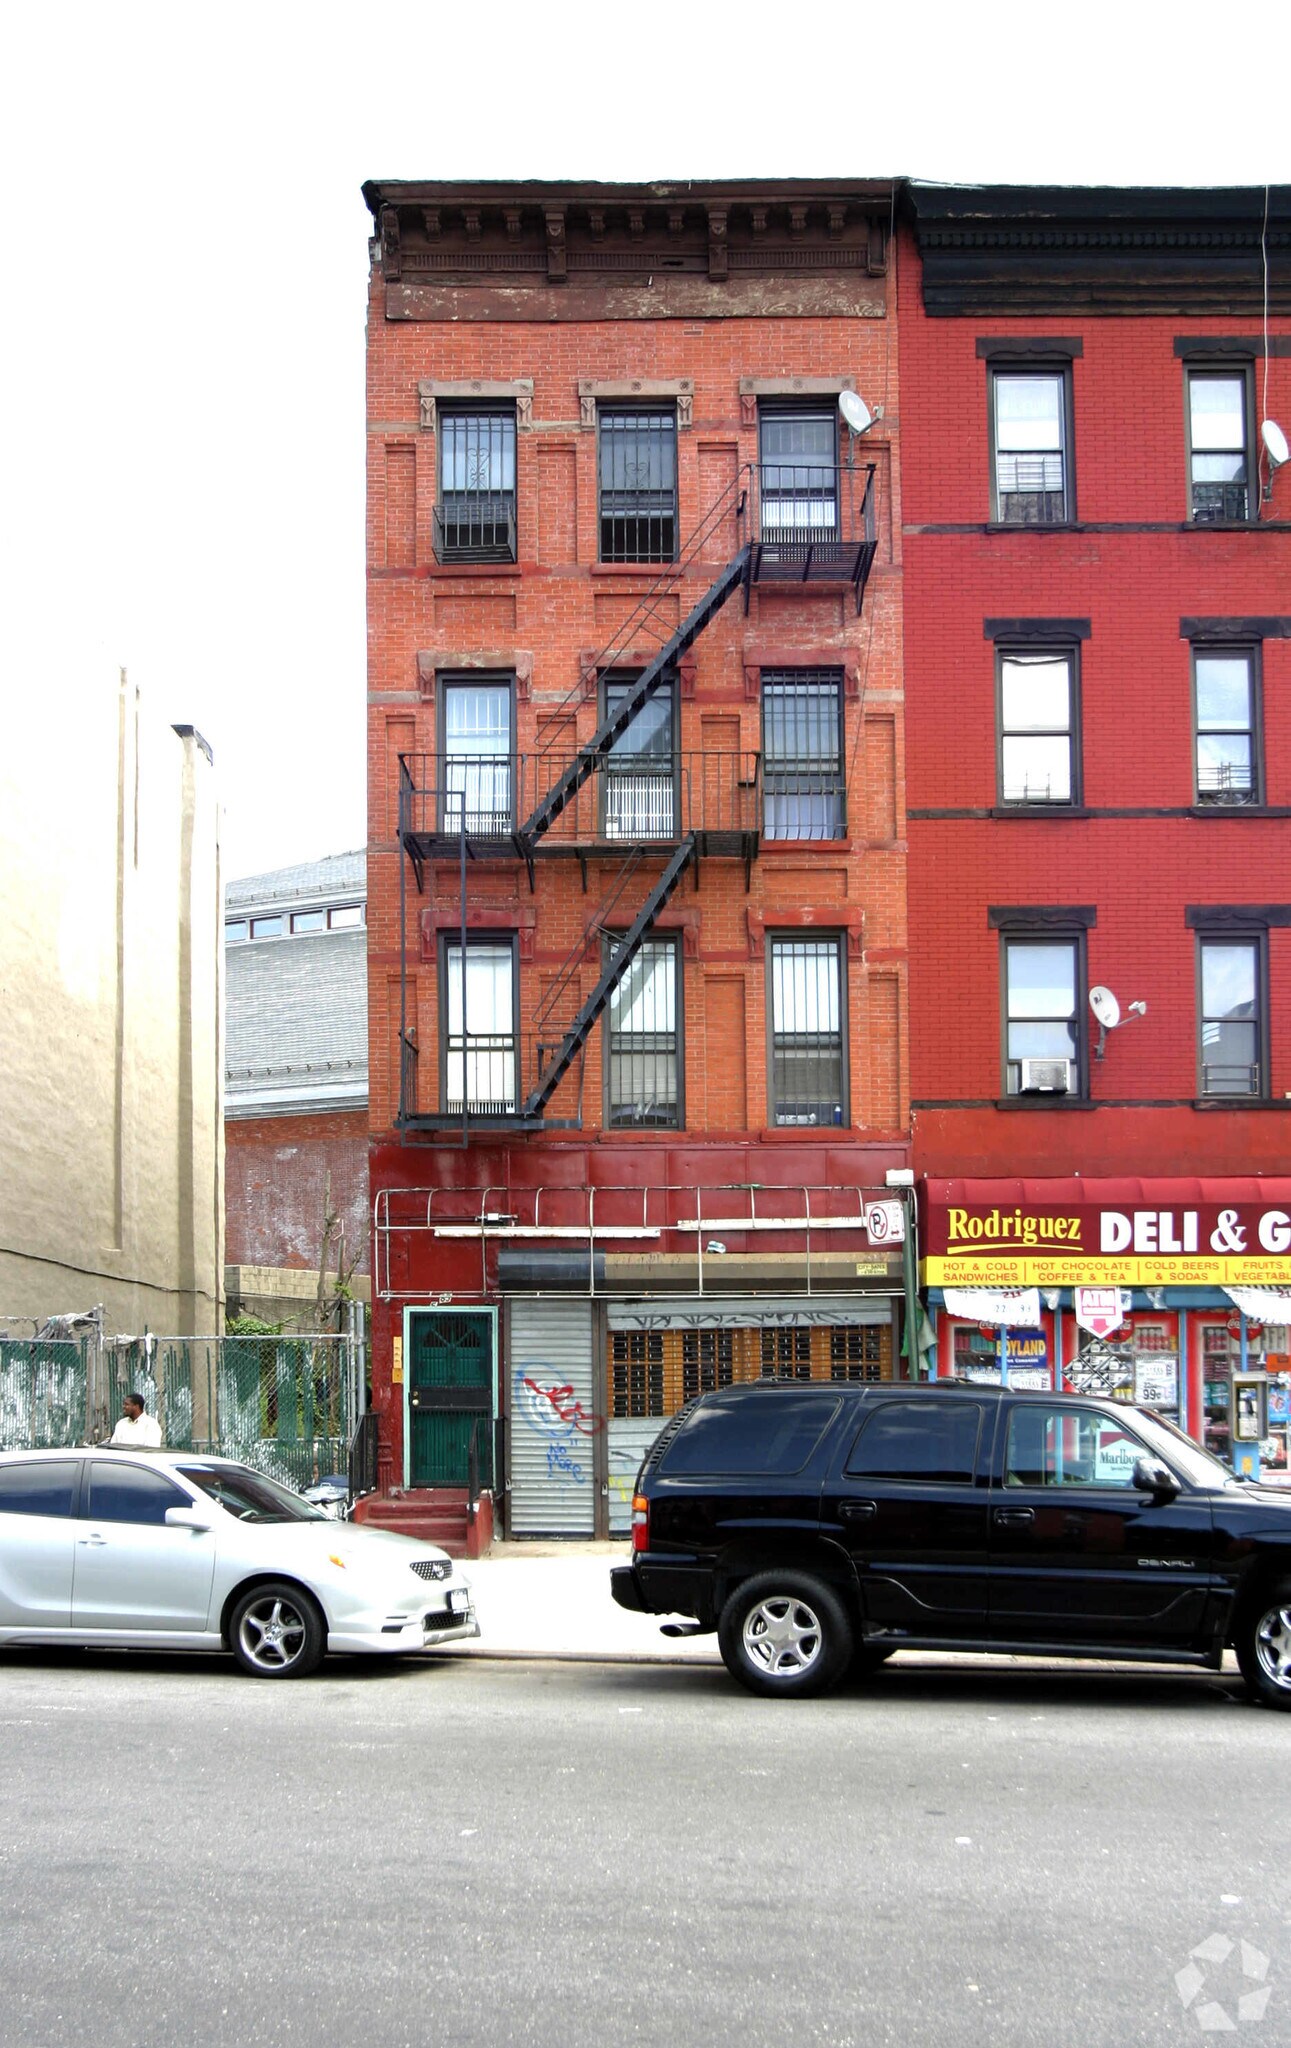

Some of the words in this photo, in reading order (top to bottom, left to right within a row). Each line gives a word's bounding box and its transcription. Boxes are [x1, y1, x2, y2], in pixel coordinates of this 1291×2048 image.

[947, 1208, 1081, 1245] Rodriguez
[1100, 1211, 1198, 1252] DELI
[1209, 1209, 1248, 1252] &
[943, 1262, 966, 1271] HOT
[972, 1262, 980, 1271] &
[986, 1262, 1018, 1271] COLD
[1032, 1262, 1056, 1271] HOT
[1061, 1262, 1132, 1271] CHOCOLATE
[1144, 1261, 1177, 1270] COLD
[1182, 1261, 1220, 1270] BEERS
[1243, 1261, 1283, 1270] FRUITS
[943, 1272, 1019, 1282] SANDWICHES
[1038, 1272, 1083, 1281] COFFEE
[1088, 1272, 1097, 1281] &
[1104, 1272, 1127, 1281] TEA
[1155, 1272, 1163, 1281] &
[1169, 1272, 1208, 1281] SODAS
[1082, 1289, 1115, 1307] ATM
[1137, 1558, 1195, 1567] DENALI
